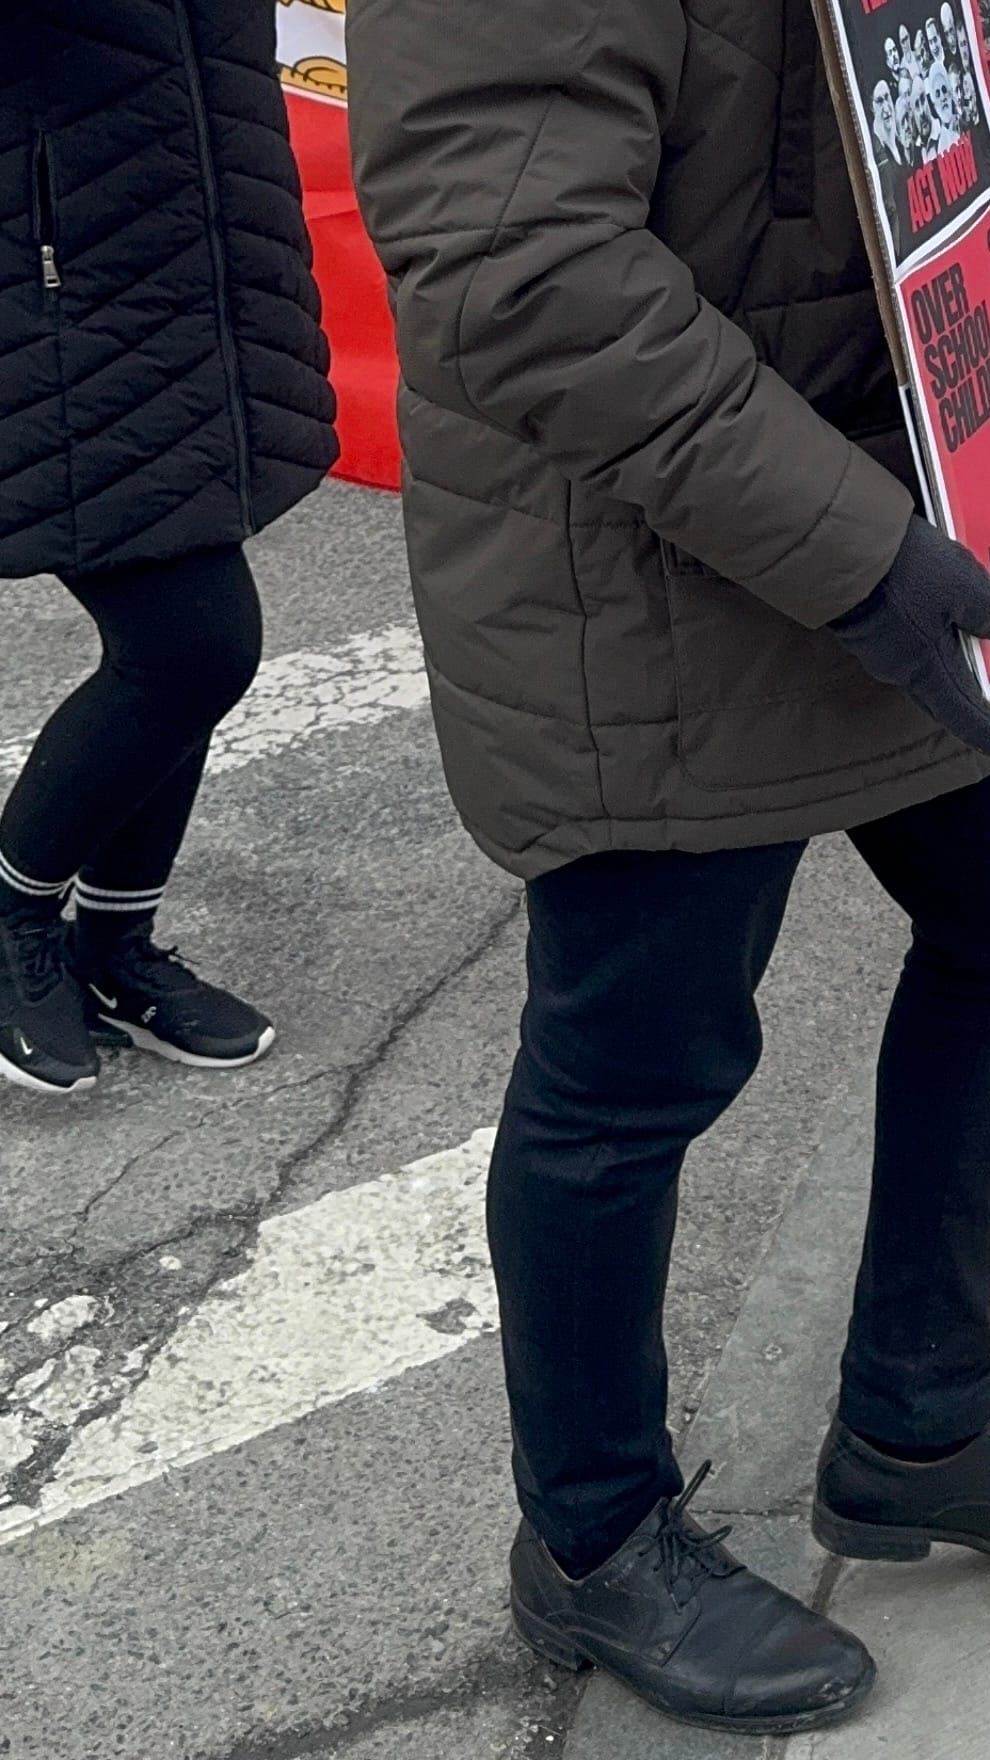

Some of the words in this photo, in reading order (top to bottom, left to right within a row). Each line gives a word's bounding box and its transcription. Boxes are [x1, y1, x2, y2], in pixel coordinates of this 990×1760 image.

[905, 162, 942, 234] ACT
[937, 131, 979, 206] NOW
[911, 262, 970, 345] OVER
